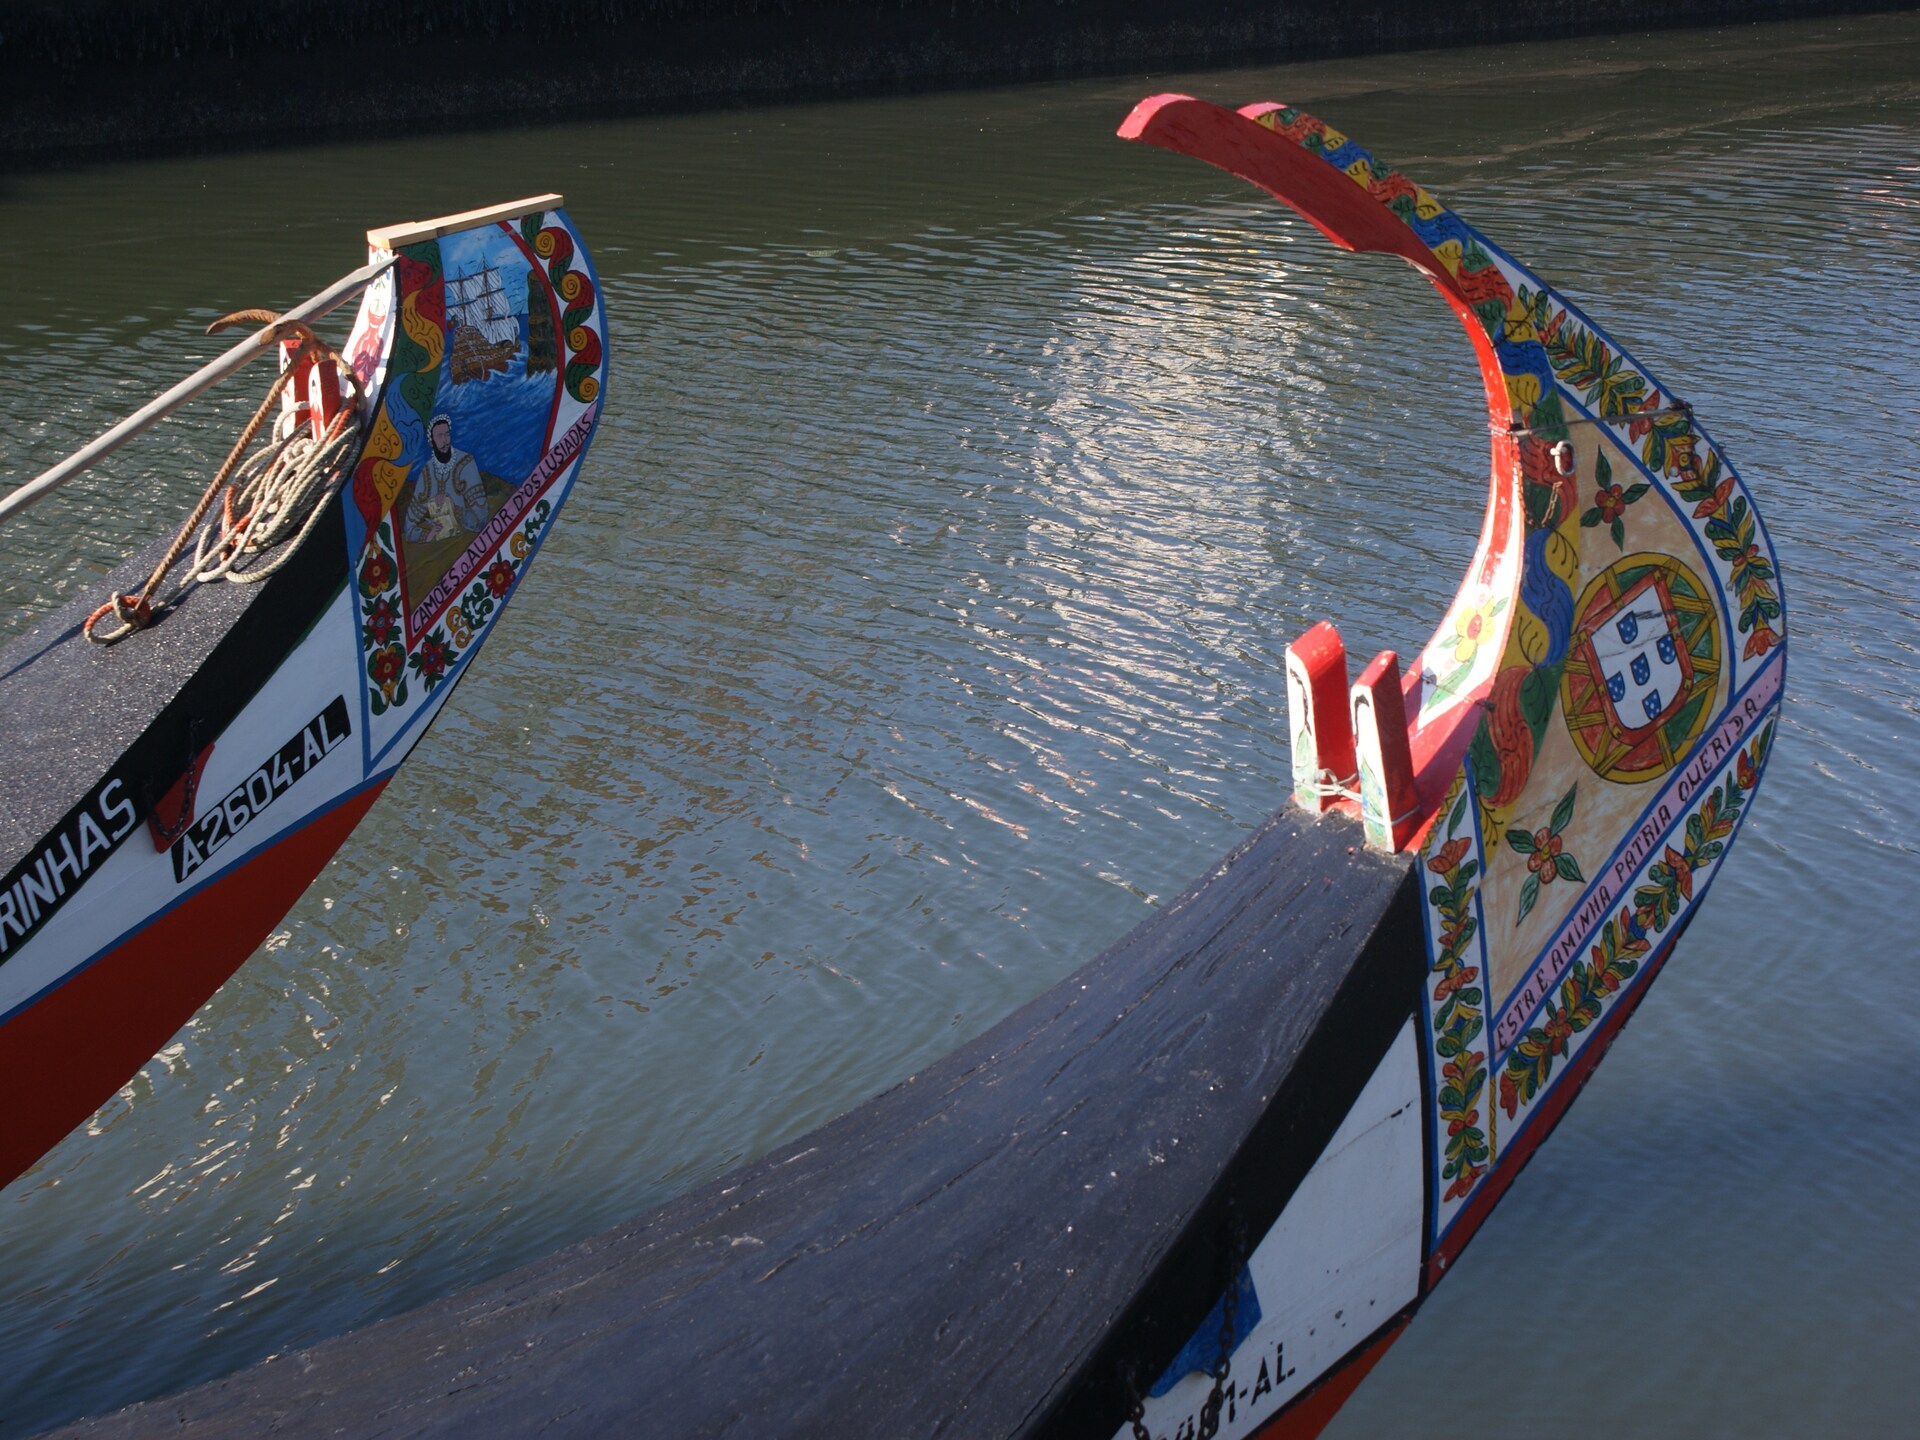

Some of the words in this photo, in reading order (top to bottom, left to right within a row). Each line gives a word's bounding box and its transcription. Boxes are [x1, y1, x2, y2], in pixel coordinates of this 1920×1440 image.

[538, 413, 592, 480] LUSIADAS
[181, 714, 346, 880] A-2604-AL
[1495, 988, 1537, 1050] ESTA
[1614, 804, 1672, 883] PATRIA
